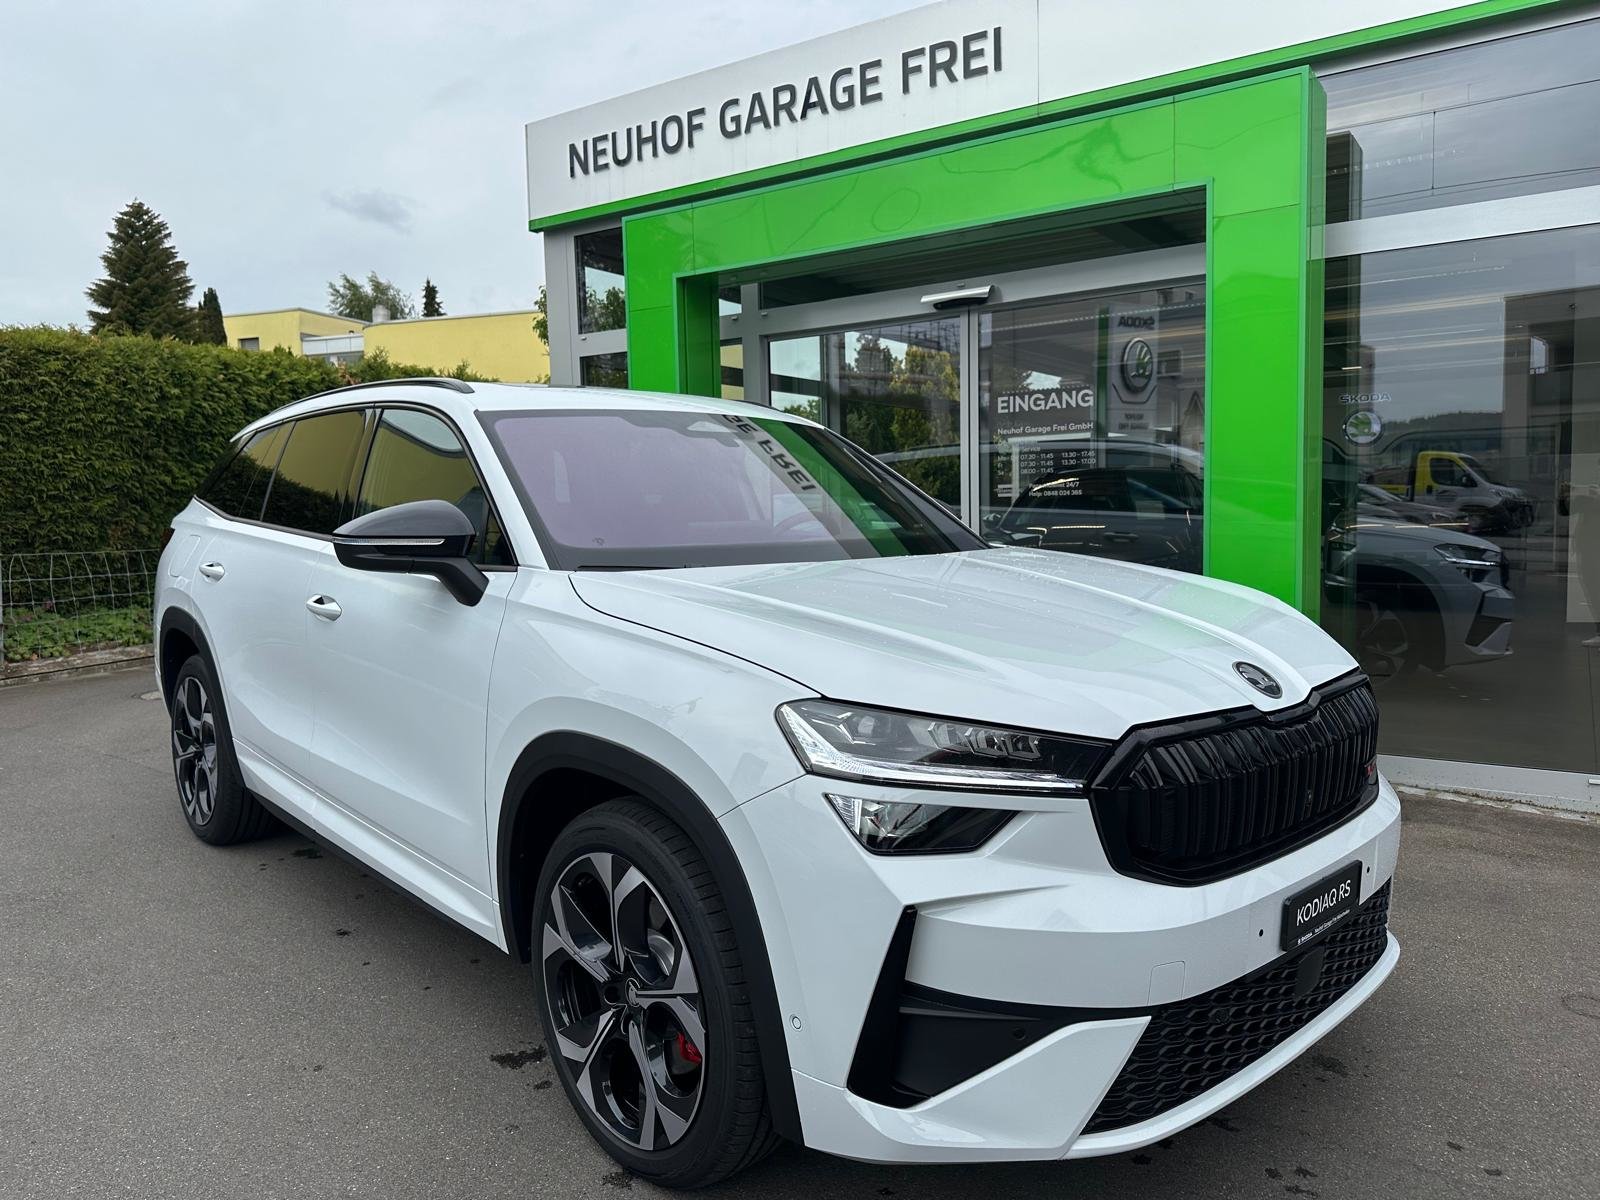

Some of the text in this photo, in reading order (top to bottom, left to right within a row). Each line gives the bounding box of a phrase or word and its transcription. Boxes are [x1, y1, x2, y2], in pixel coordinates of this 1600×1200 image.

[569, 26, 1003, 178] NEUHOF GARAGE FREI
[997, 389, 1094, 414] EINGANG
[997, 422, 1094, 435] Neuhof Garage Frei GmbH
[1296, 879, 1352, 926] KODIAQ RS
